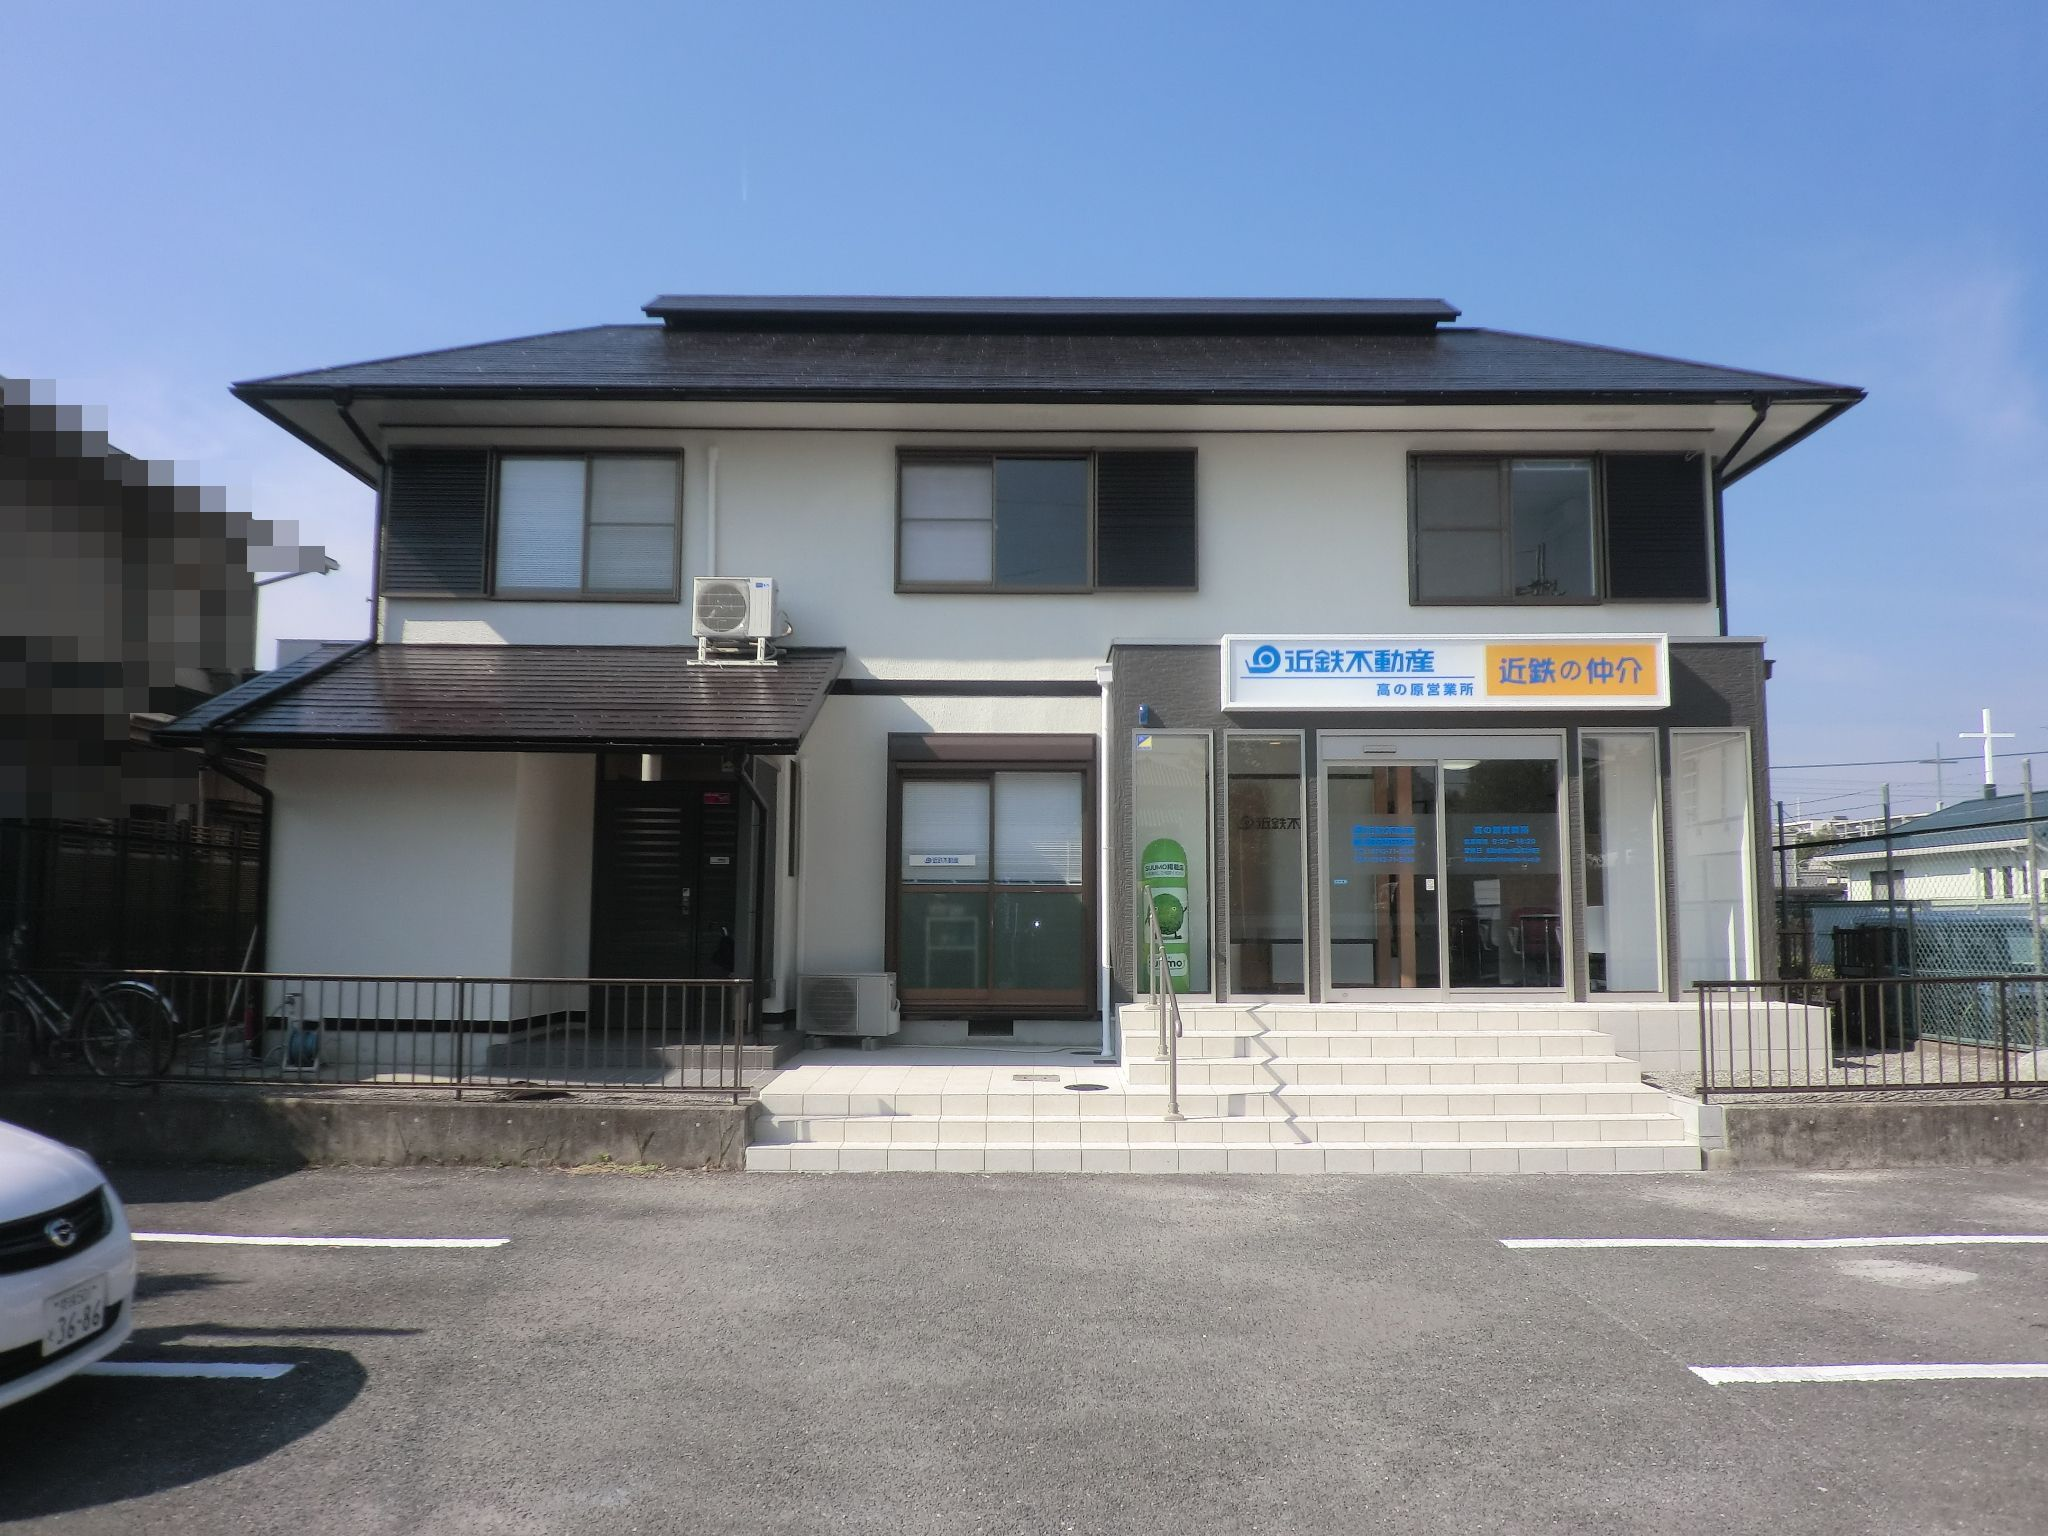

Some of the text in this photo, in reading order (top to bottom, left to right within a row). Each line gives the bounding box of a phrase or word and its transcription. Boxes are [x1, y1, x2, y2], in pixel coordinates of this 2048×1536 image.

[1284, 648, 1435, 673] 近鉄不動産
[1498, 656, 1643, 685] 近鉄の仲介
[1376, 682, 1475, 697] 高の原営業所
